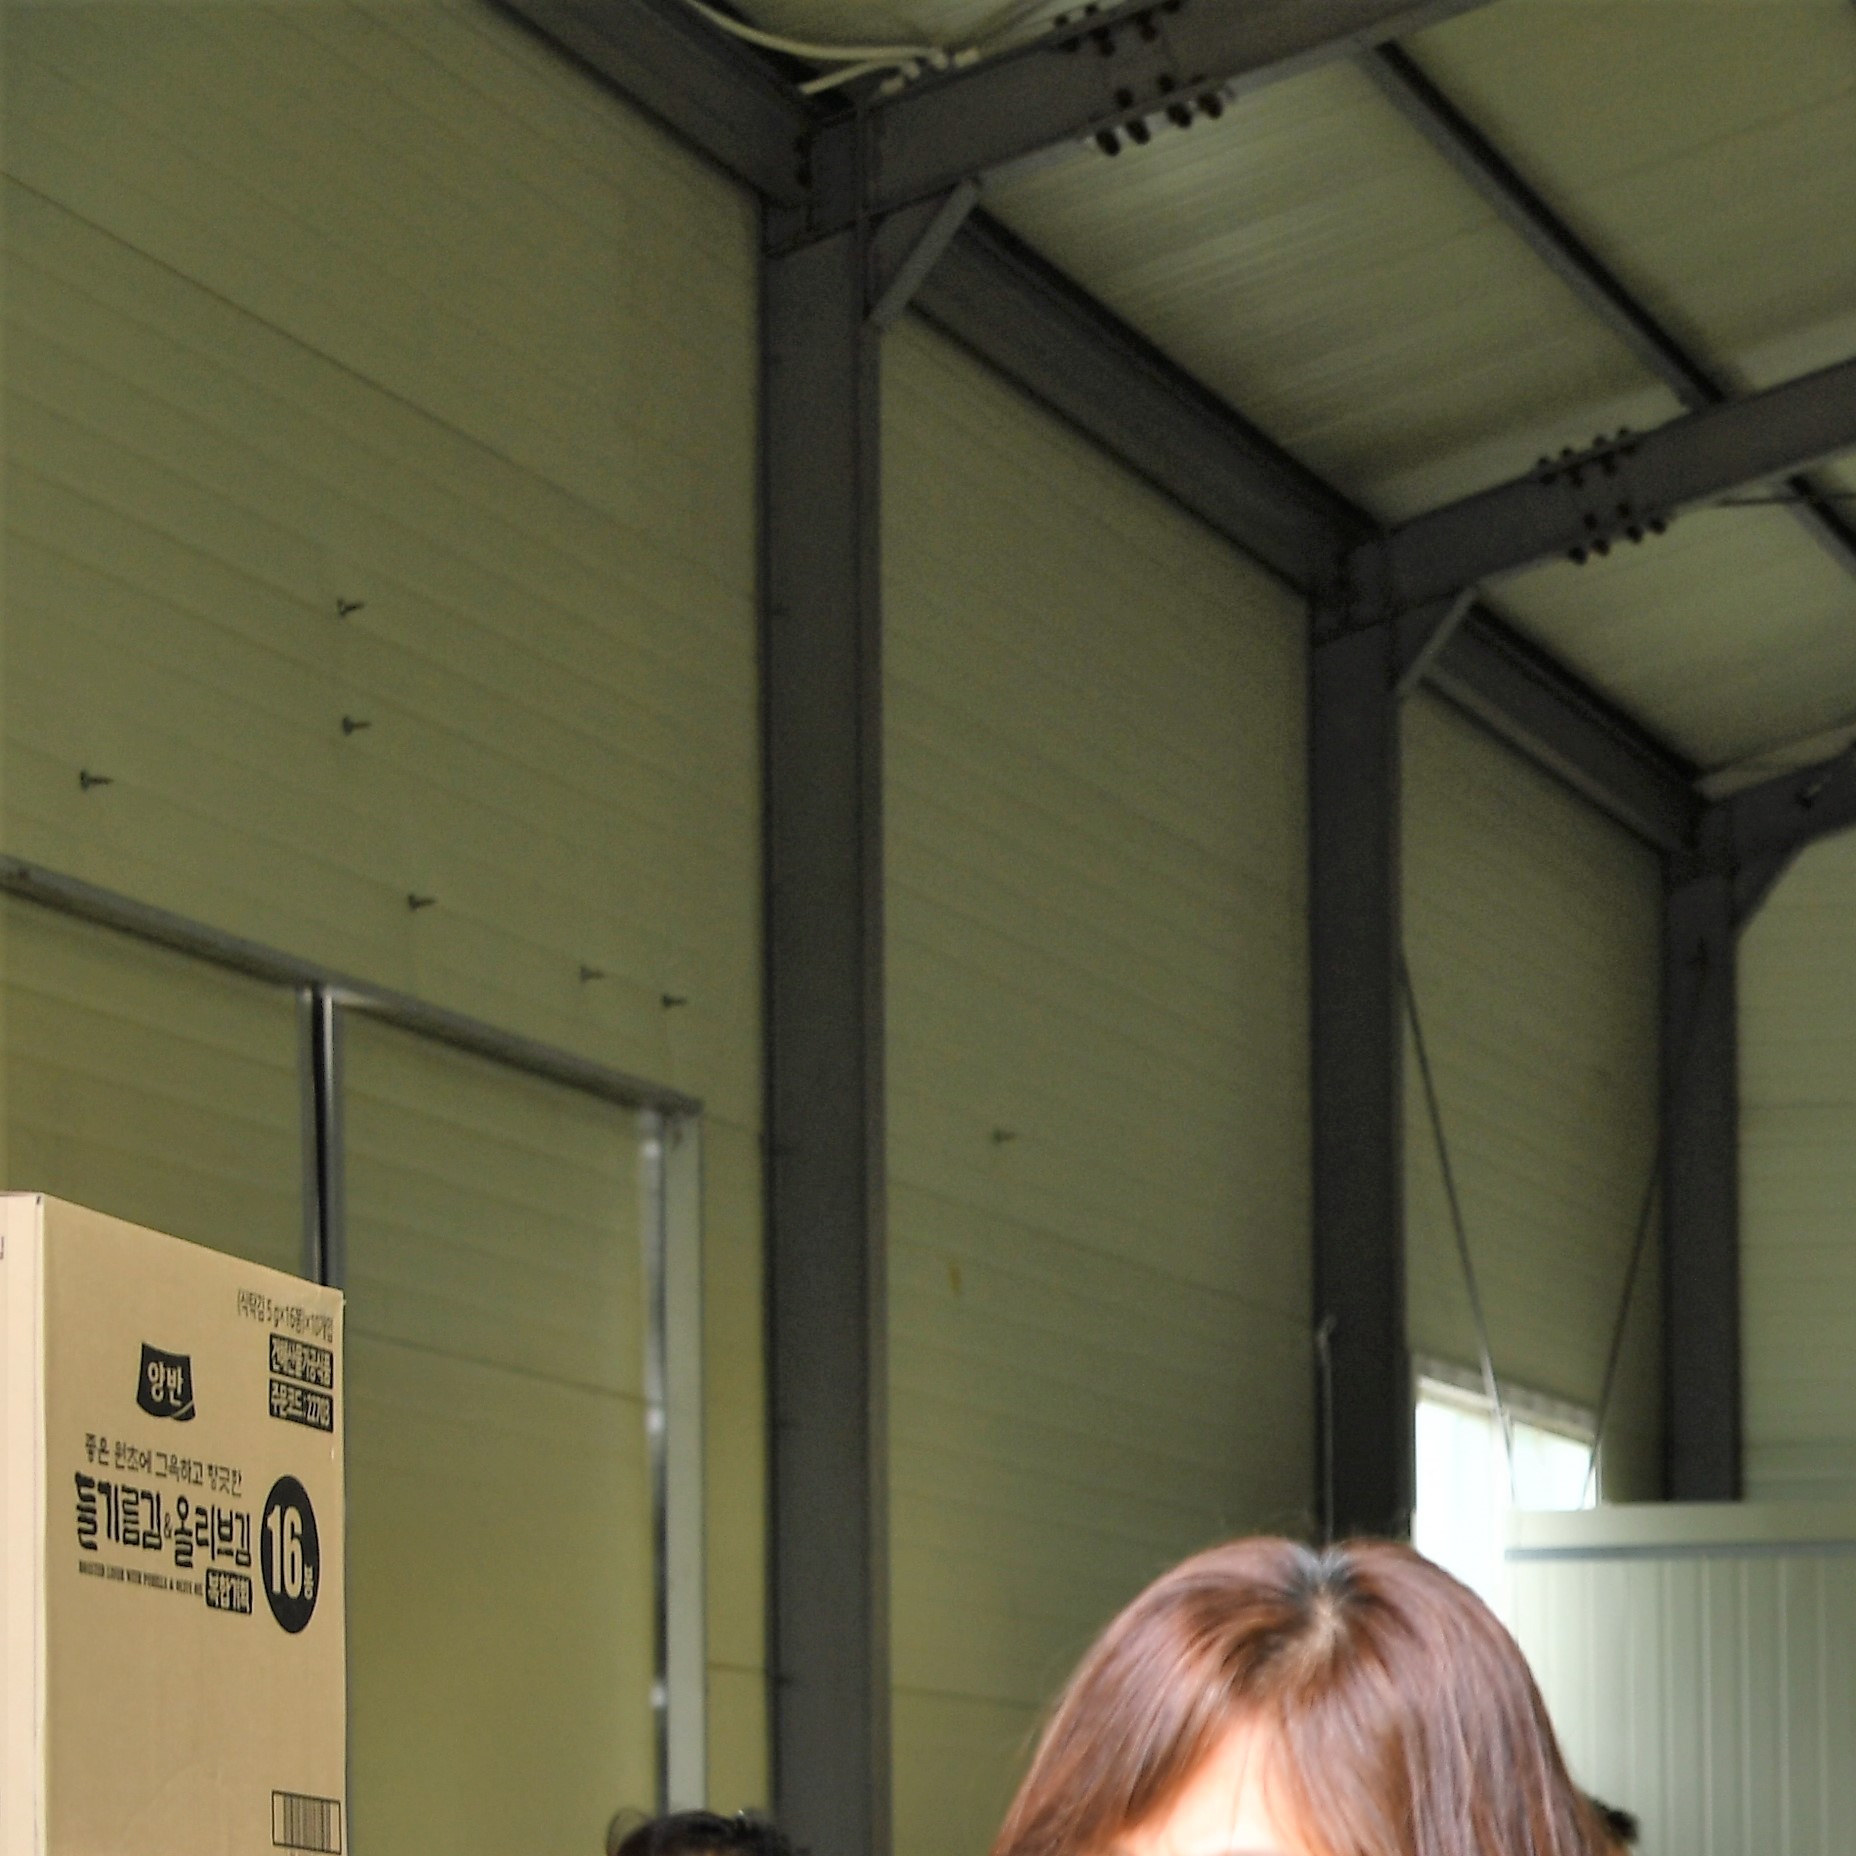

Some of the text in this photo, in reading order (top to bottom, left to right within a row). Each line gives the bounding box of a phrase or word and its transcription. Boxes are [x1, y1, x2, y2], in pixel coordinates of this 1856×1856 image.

[147, 1361, 184, 1407] 양반
[85, 1433, 243, 1498] 좋은 원초에 그윽하고 향긋한
